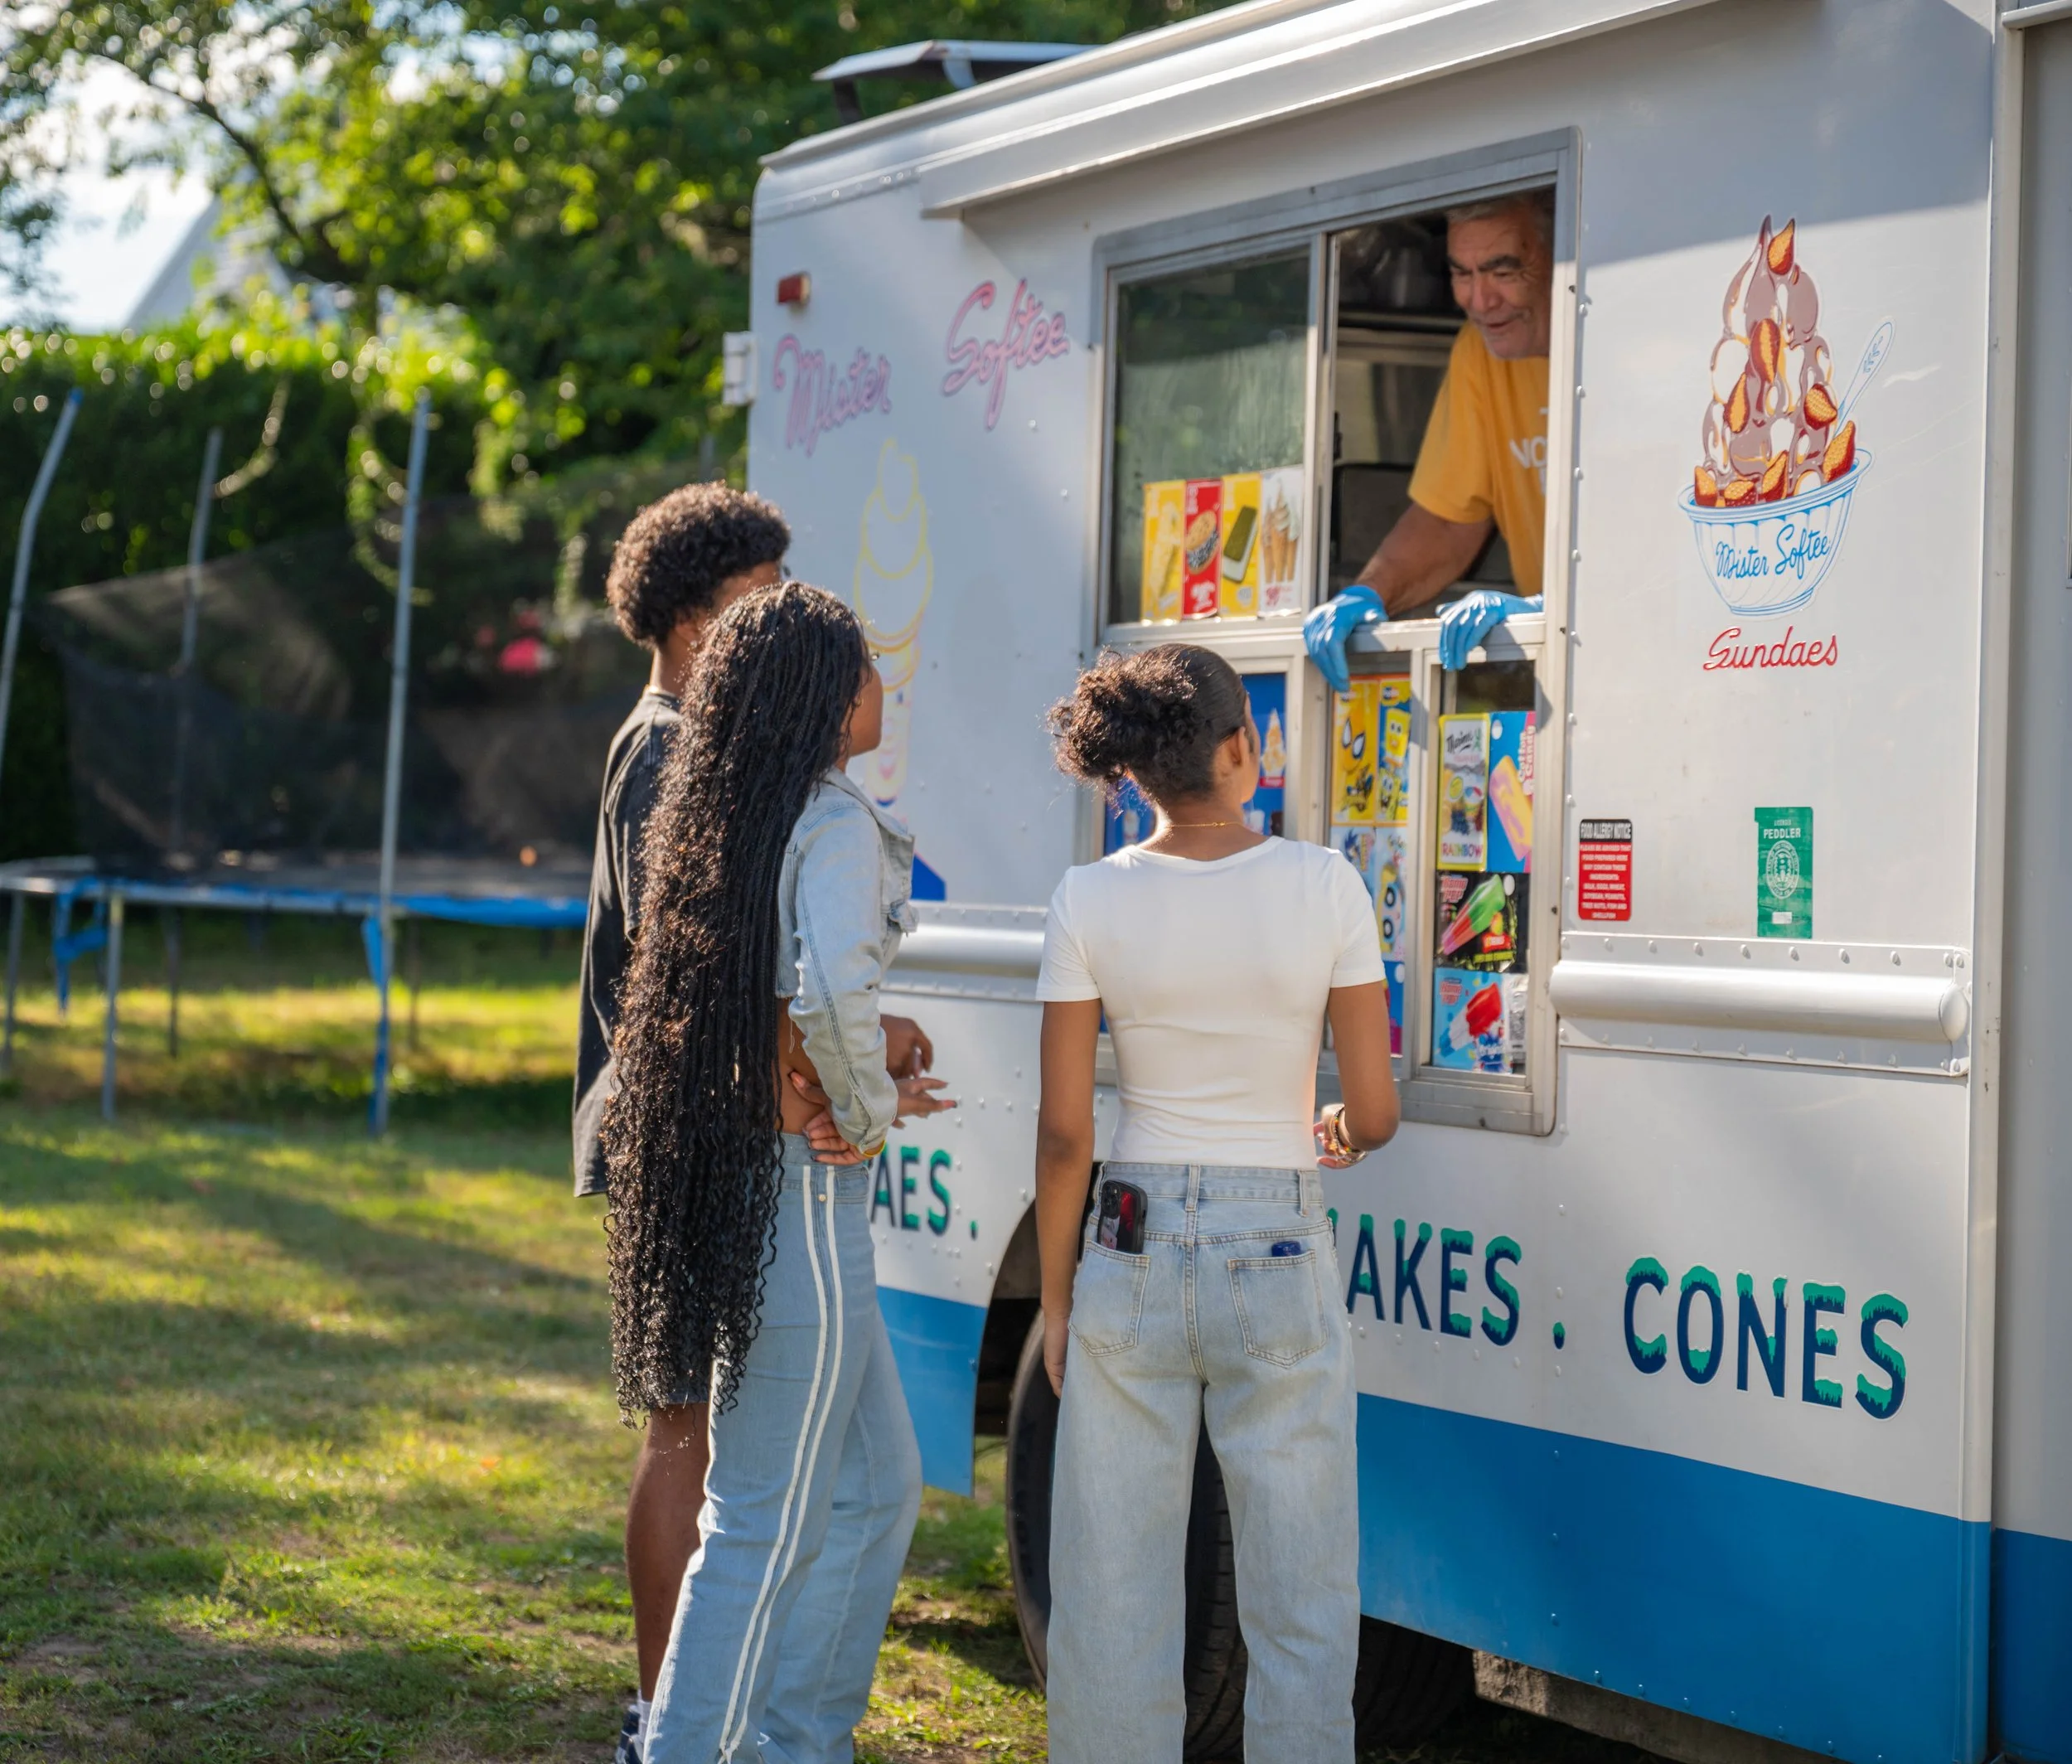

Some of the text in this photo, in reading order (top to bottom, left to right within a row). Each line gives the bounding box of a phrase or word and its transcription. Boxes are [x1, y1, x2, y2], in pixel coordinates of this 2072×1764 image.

[772, 277, 1070, 458] Mister Softee
[1716, 524, 1830, 579] Mister Softee
[1703, 625, 1838, 671] Sundaes
[1441, 842, 1483, 858] RAINBOW
[1581, 822, 1631, 839] FOOD ALLERGY NOTICE
[1763, 827, 1802, 840] PEDDLER
[864, 1141, 1909, 1420] AES AKES CONES
